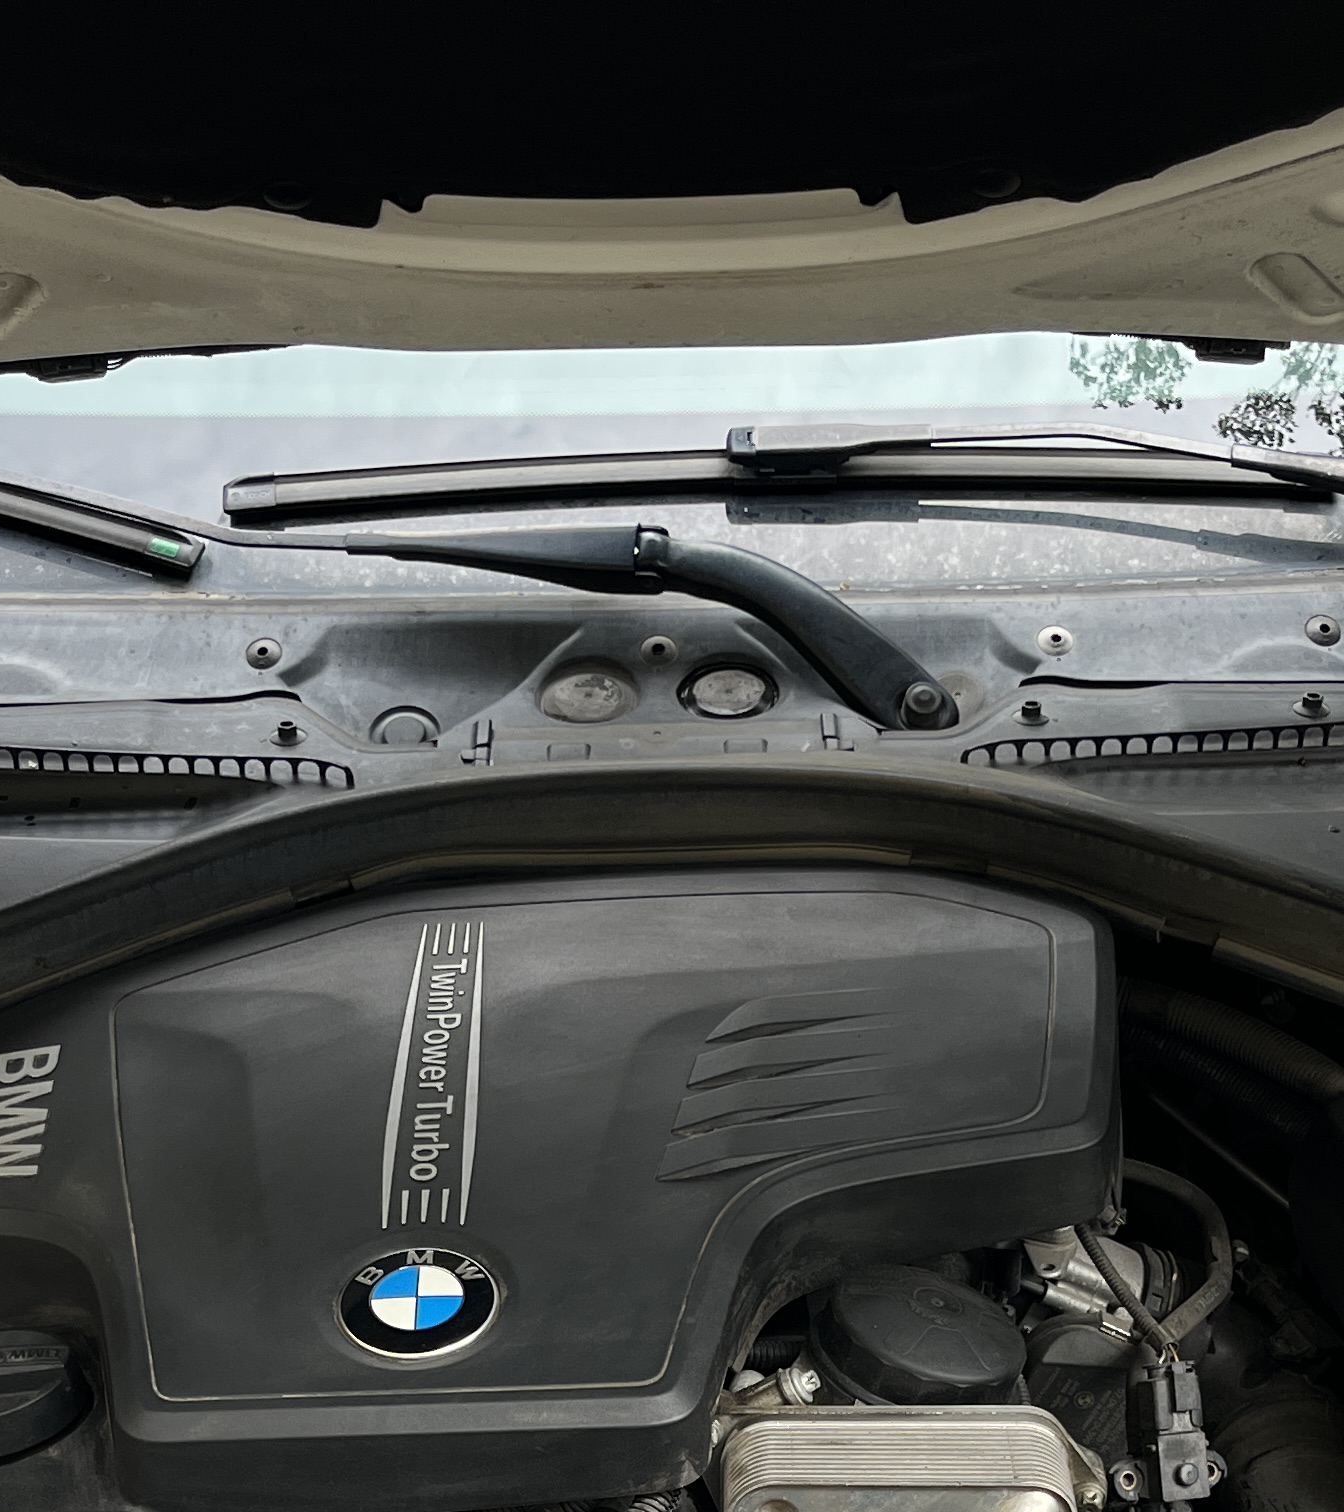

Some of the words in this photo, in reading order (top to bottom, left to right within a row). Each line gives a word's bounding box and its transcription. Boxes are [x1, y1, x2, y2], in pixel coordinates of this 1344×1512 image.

[418, 958, 468, 1092] TwinPower
[409, 1095, 454, 1181] Turbo
[355, 1250, 485, 1286] BMW
